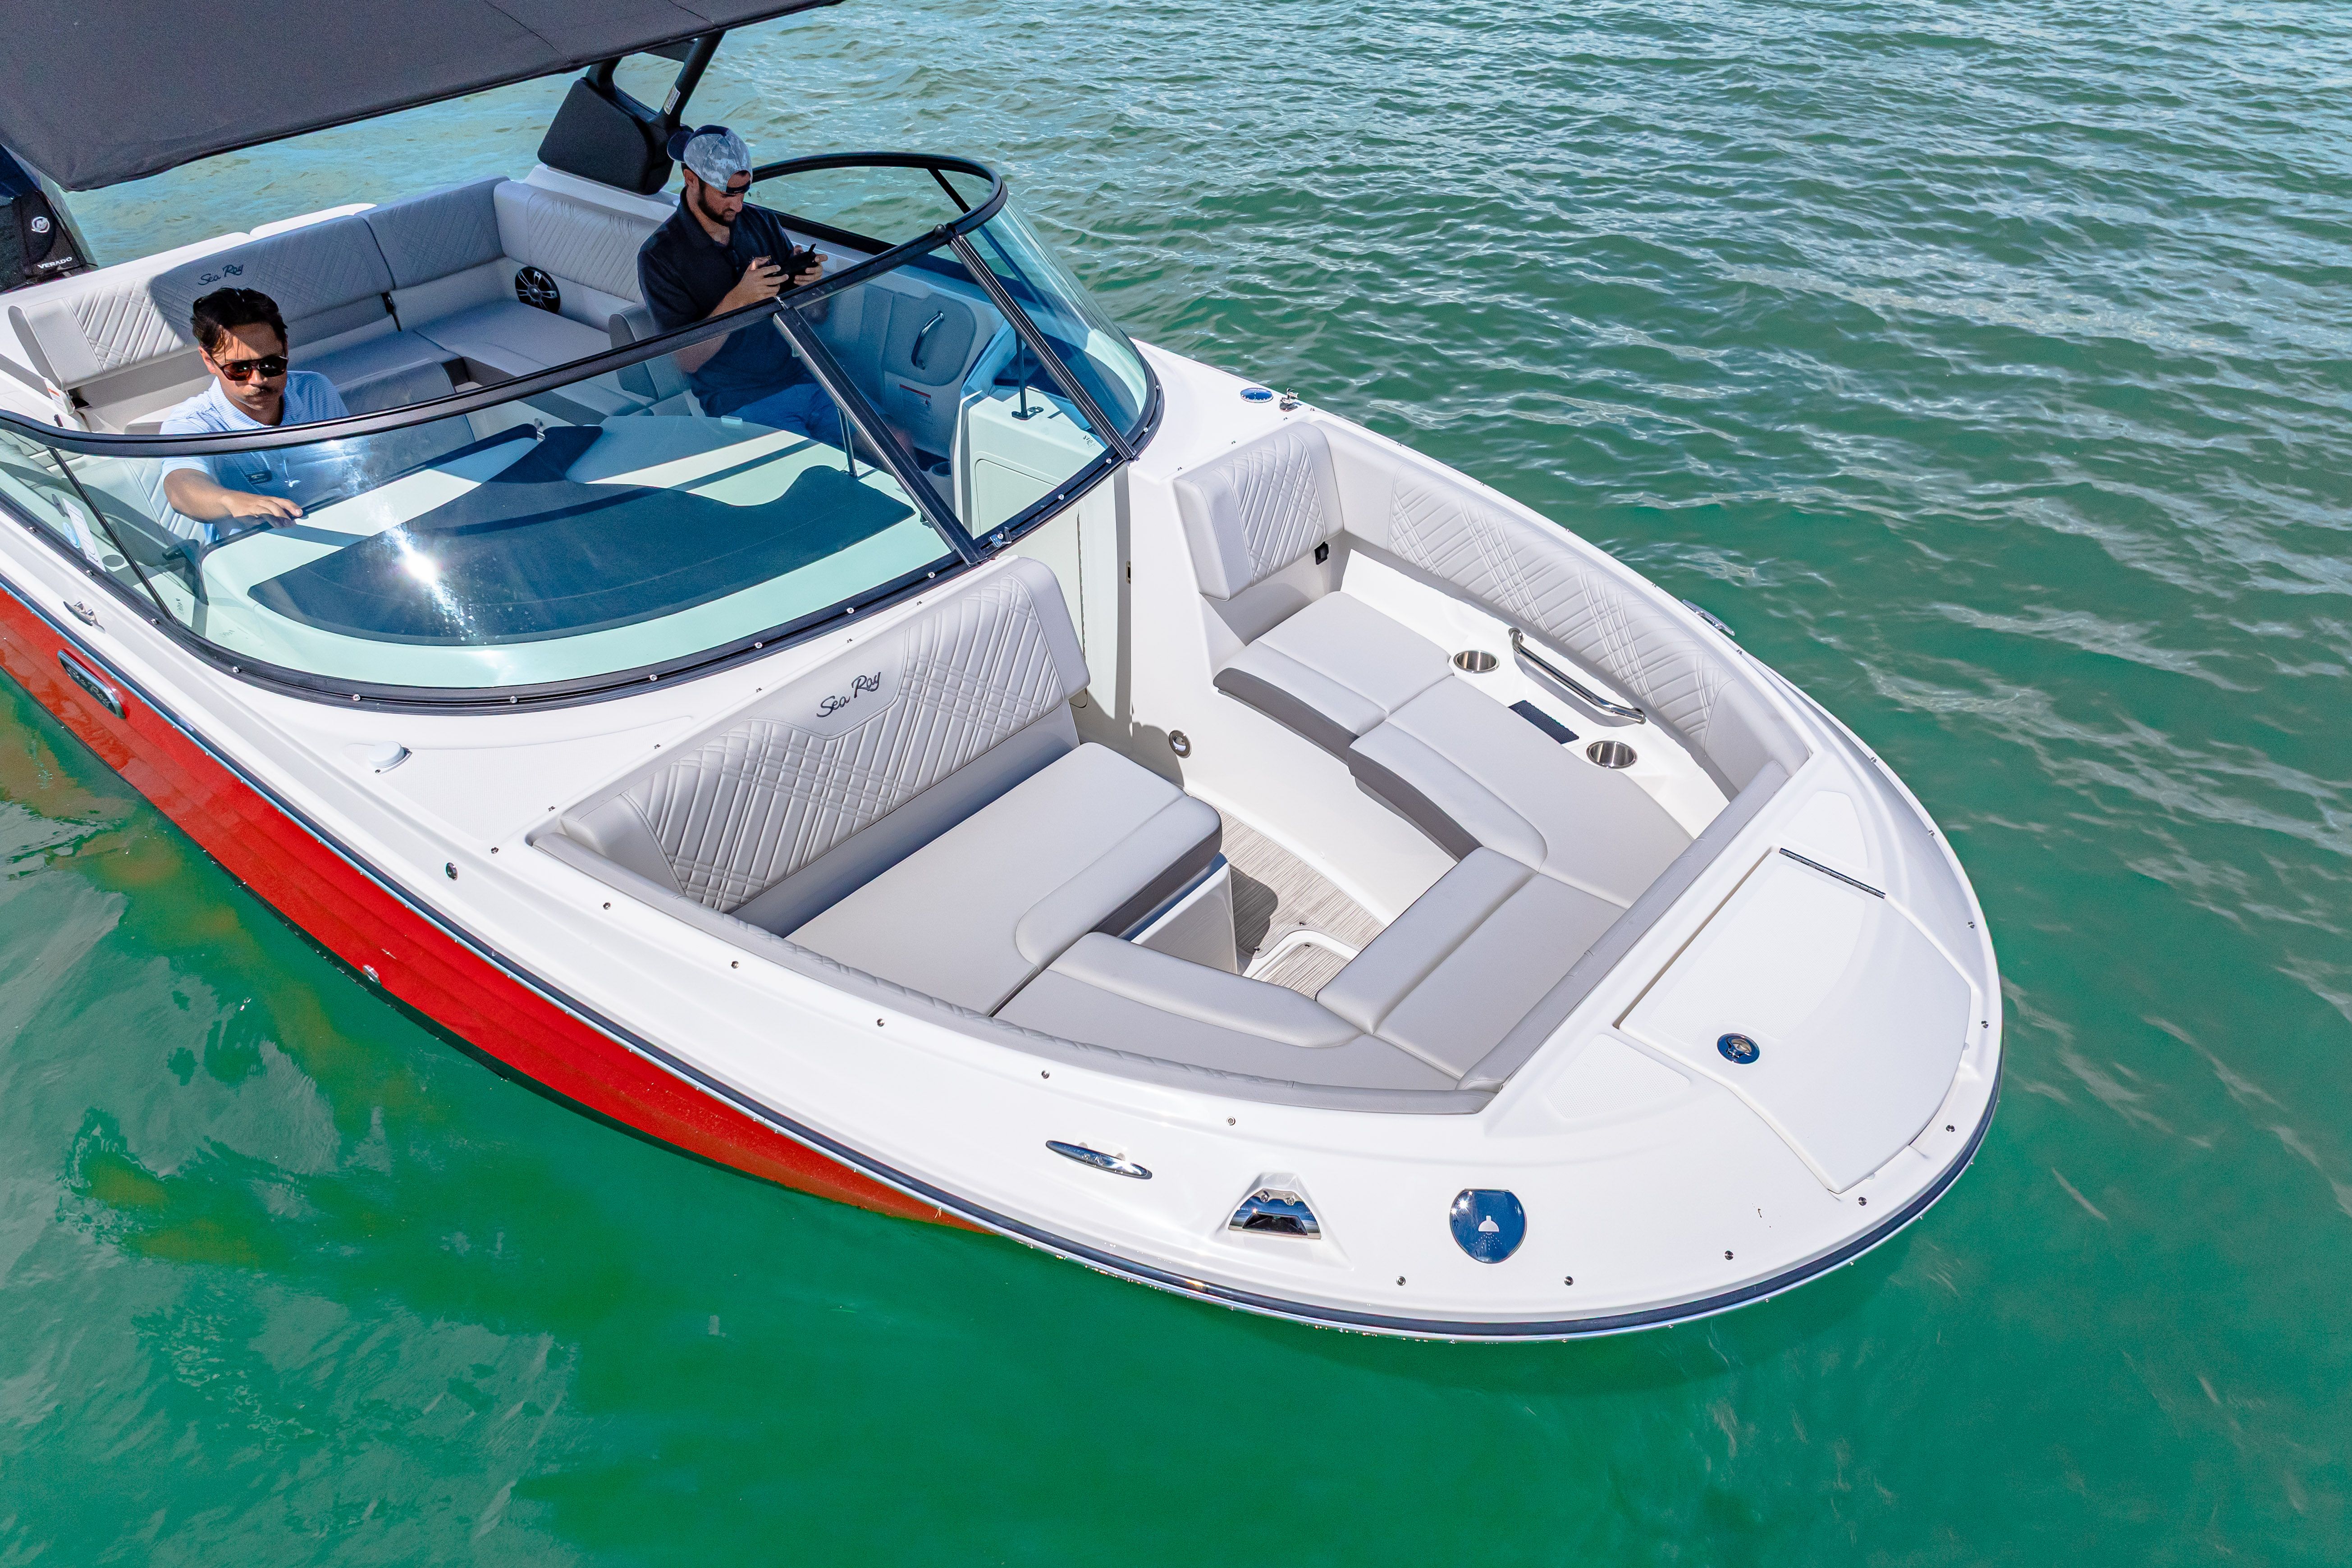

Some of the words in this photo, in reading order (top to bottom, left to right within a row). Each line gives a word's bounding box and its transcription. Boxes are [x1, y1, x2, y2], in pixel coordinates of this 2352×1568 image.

[37, 256, 73, 269] VERADO
[198, 273, 221, 286] Sea
[222, 264, 244, 278] Ray
[66, 666, 87, 687] Sea
[88, 681, 111, 707] Ray
[816, 695, 850, 718] Sea
[851, 672, 881, 698] Ray
